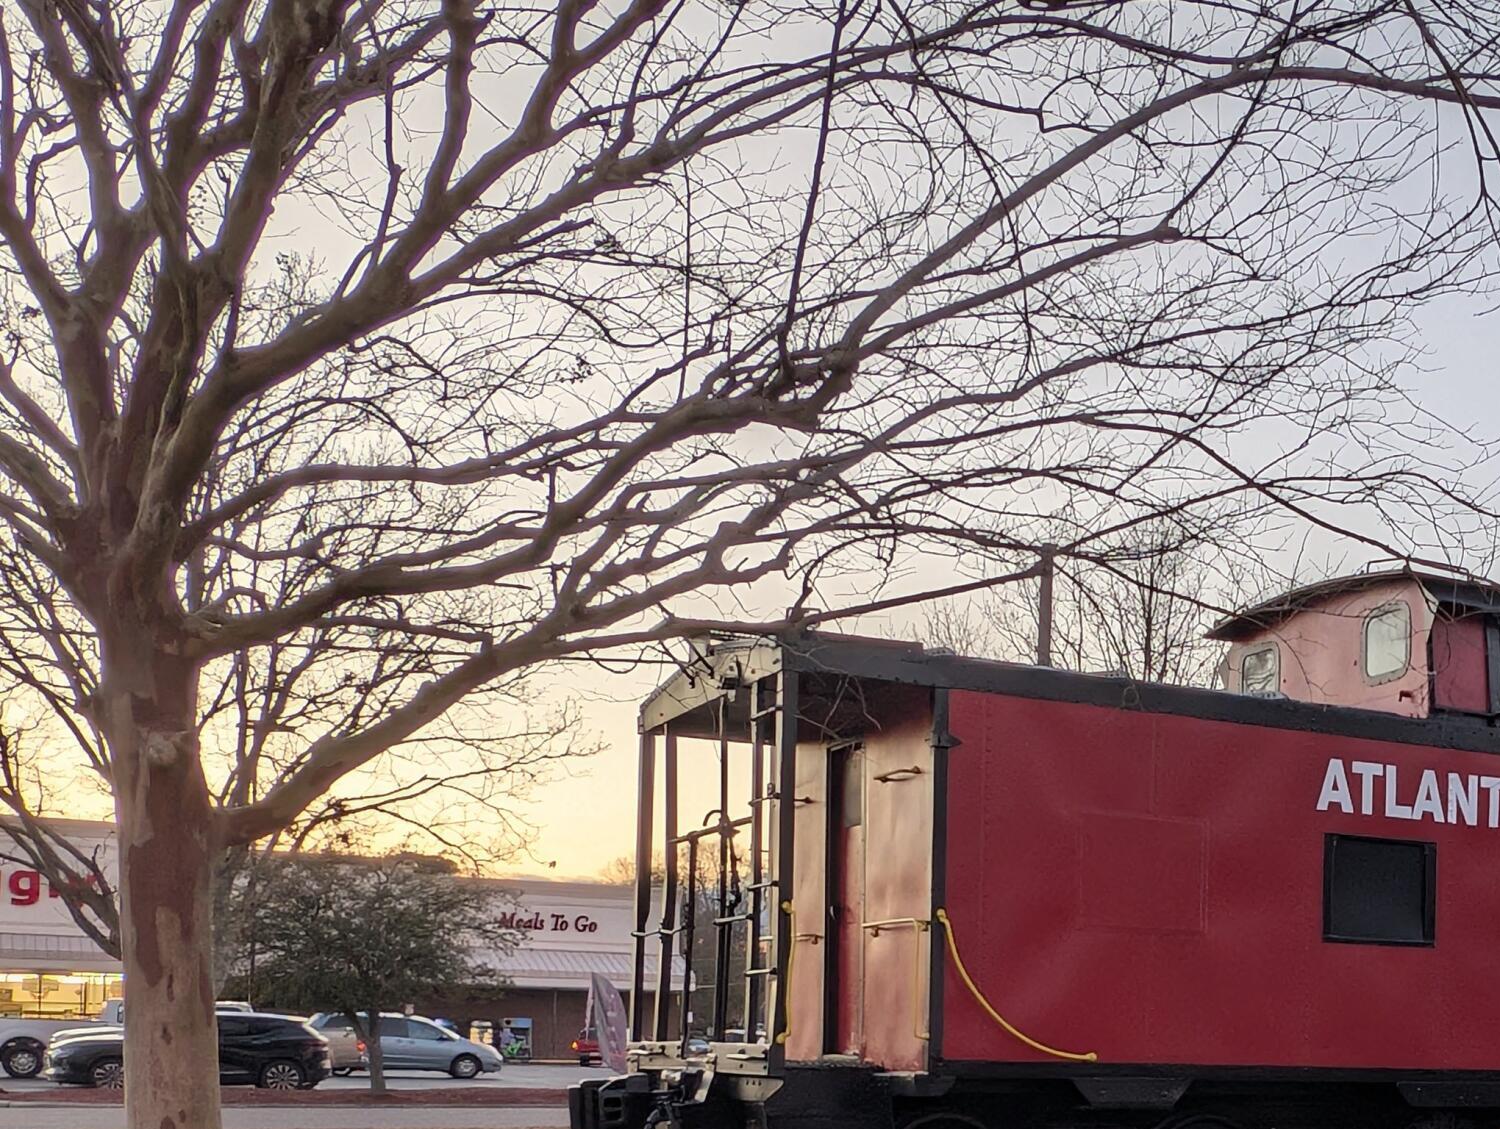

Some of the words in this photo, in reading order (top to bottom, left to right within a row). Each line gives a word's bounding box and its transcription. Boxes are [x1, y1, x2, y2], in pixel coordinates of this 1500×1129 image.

[500, 912, 545, 931] Meals
[551, 914, 569, 931] To
[575, 916, 598, 932] Go
